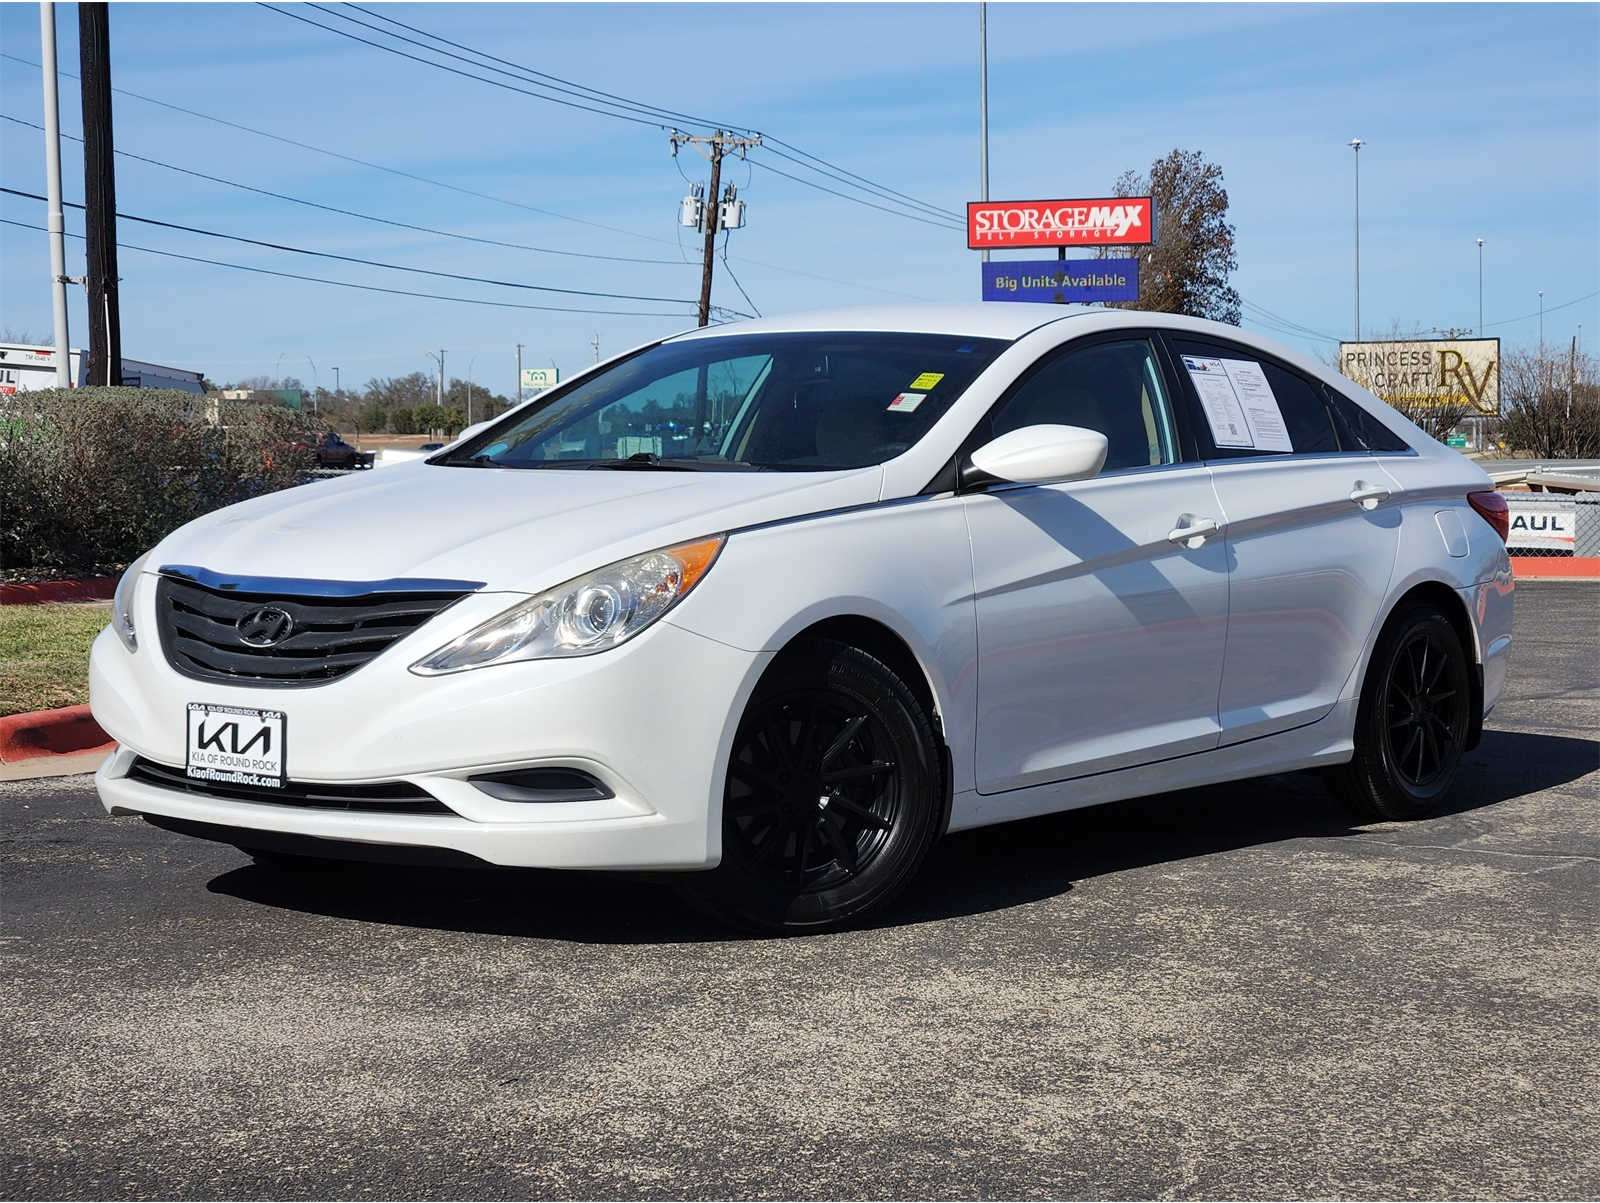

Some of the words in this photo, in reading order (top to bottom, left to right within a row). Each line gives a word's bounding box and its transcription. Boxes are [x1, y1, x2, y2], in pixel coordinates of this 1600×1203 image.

[975, 205, 1143, 237] STORAGEMAX
[976, 231, 1015, 240] SELF
[1034, 230, 1112, 239] STORAGE
[995, 276, 1018, 291] Big
[1022, 275, 1057, 288] Units
[1062, 273, 1126, 288] Available
[1346, 351, 1432, 366] PRINCESS
[1436, 349, 1496, 415] RV
[1374, 372, 1433, 388] CRAFT
[1510, 515, 1565, 531] AUL
[198, 720, 271, 757] KIA
[191, 751, 206, 761] KIA
[207, 753, 219, 763] OF
[220, 755, 251, 768] ROUND
[252, 759, 278, 772] ROCK
[186, 765, 281, 788] KiaofRoundRock.com
